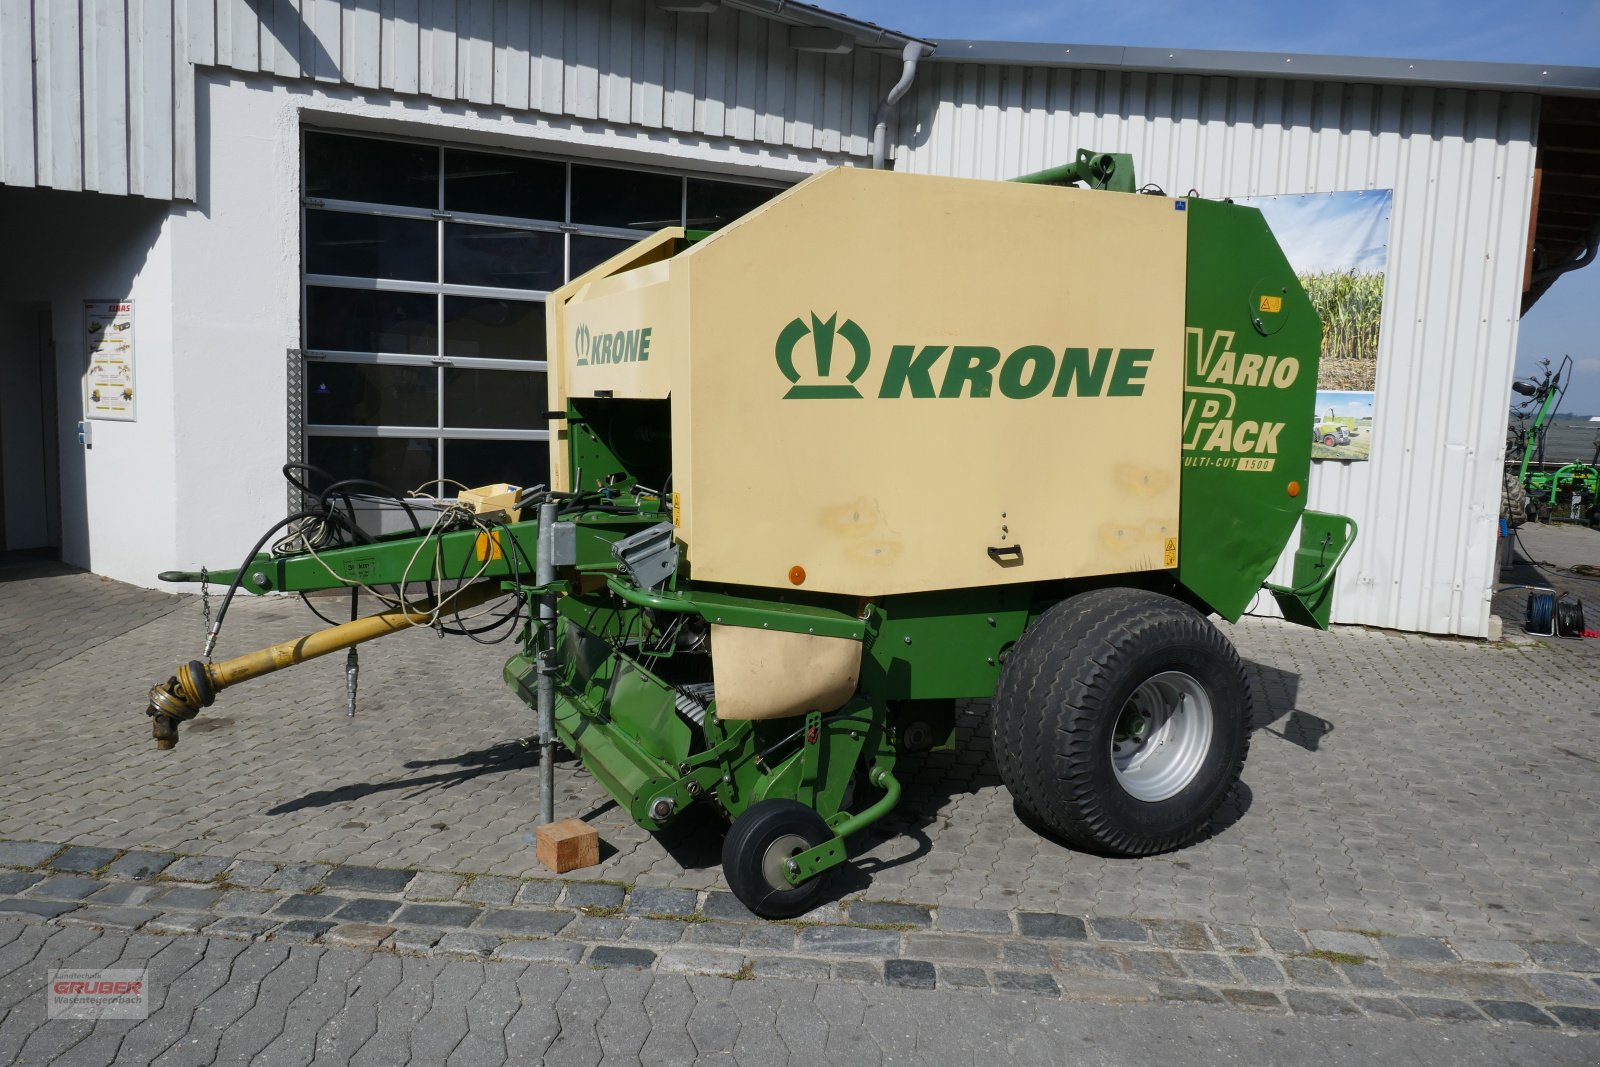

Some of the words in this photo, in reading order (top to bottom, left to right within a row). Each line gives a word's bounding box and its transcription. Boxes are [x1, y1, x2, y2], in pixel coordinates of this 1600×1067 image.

[591, 327, 652, 365] KRONE
[1184, 326, 1300, 389] VARIO
[878, 345, 1155, 400] KRONE
[1182, 456, 1238, 468] ULTI-CUT
[1244, 459, 1270, 471] 1500
